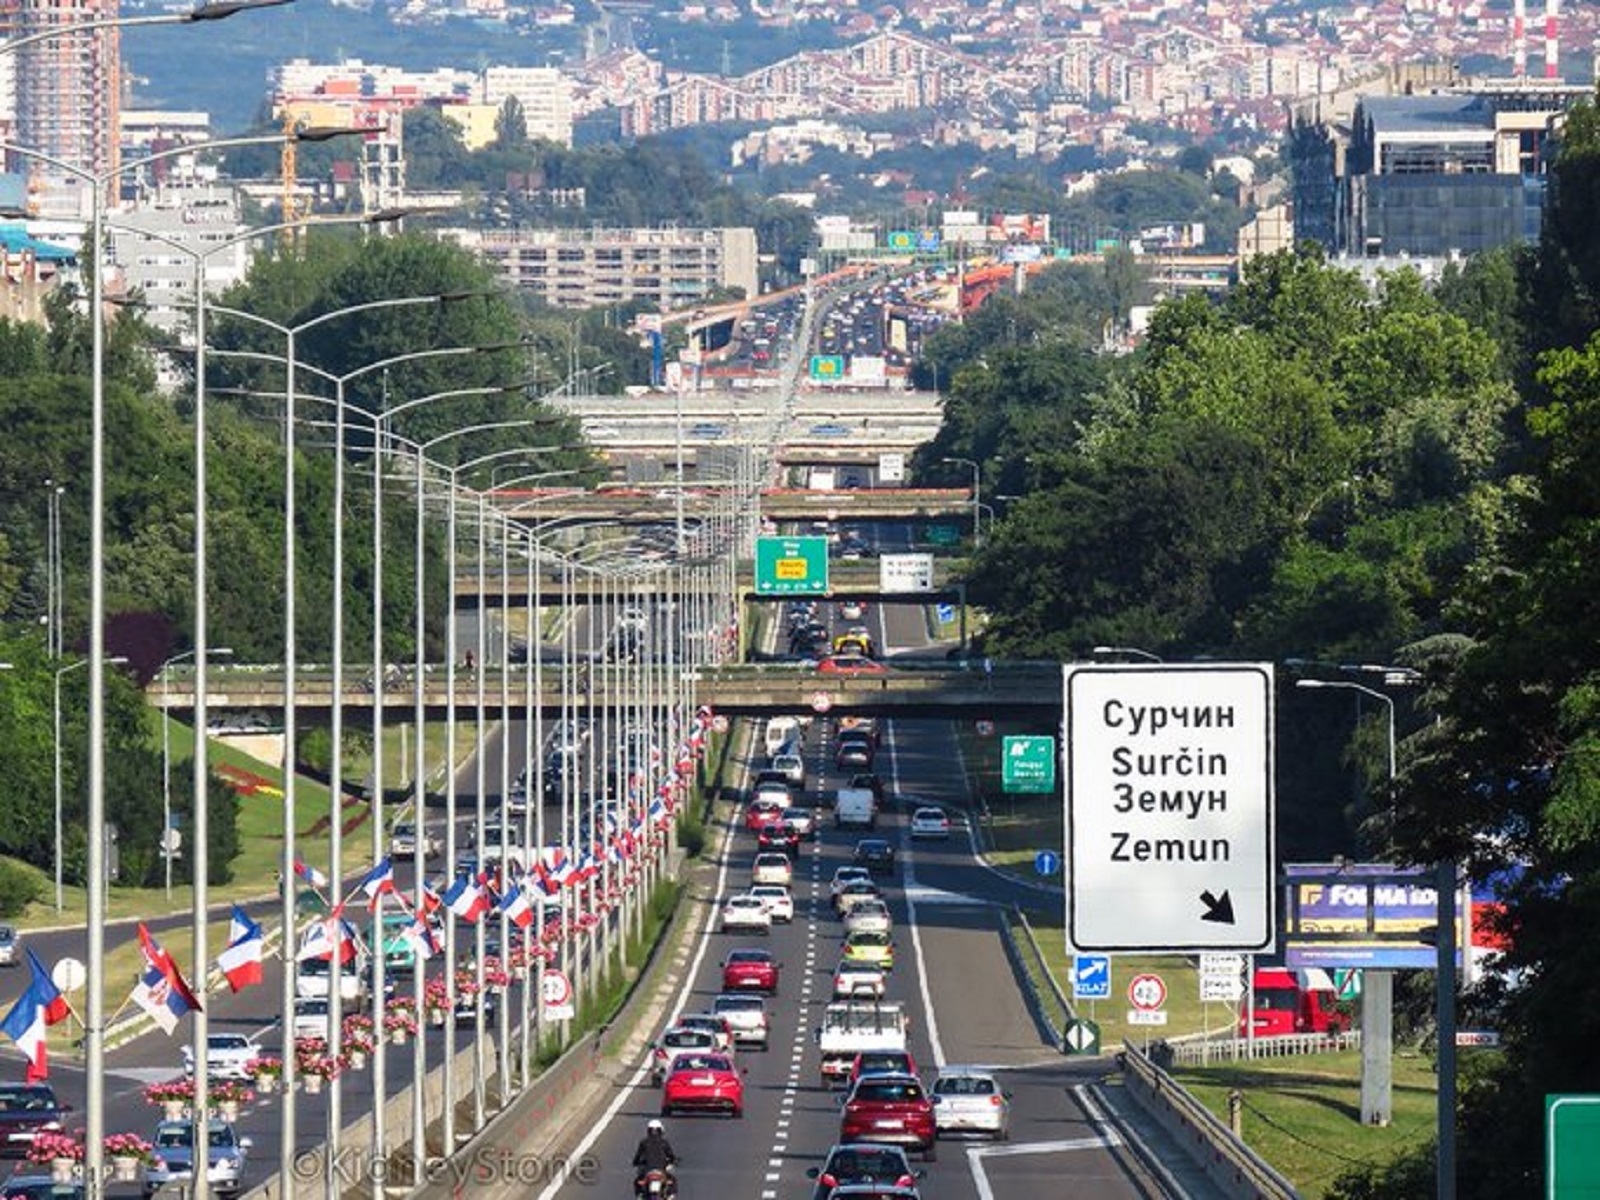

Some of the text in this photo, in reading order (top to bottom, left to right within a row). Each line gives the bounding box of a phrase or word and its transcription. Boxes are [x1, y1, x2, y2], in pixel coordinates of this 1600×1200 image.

[1104, 700, 1234, 735] Сурчин
[1112, 747, 1227, 775] Surčin
[1113, 784, 1226, 819] Земун
[1110, 833, 1229, 861] Zemun
